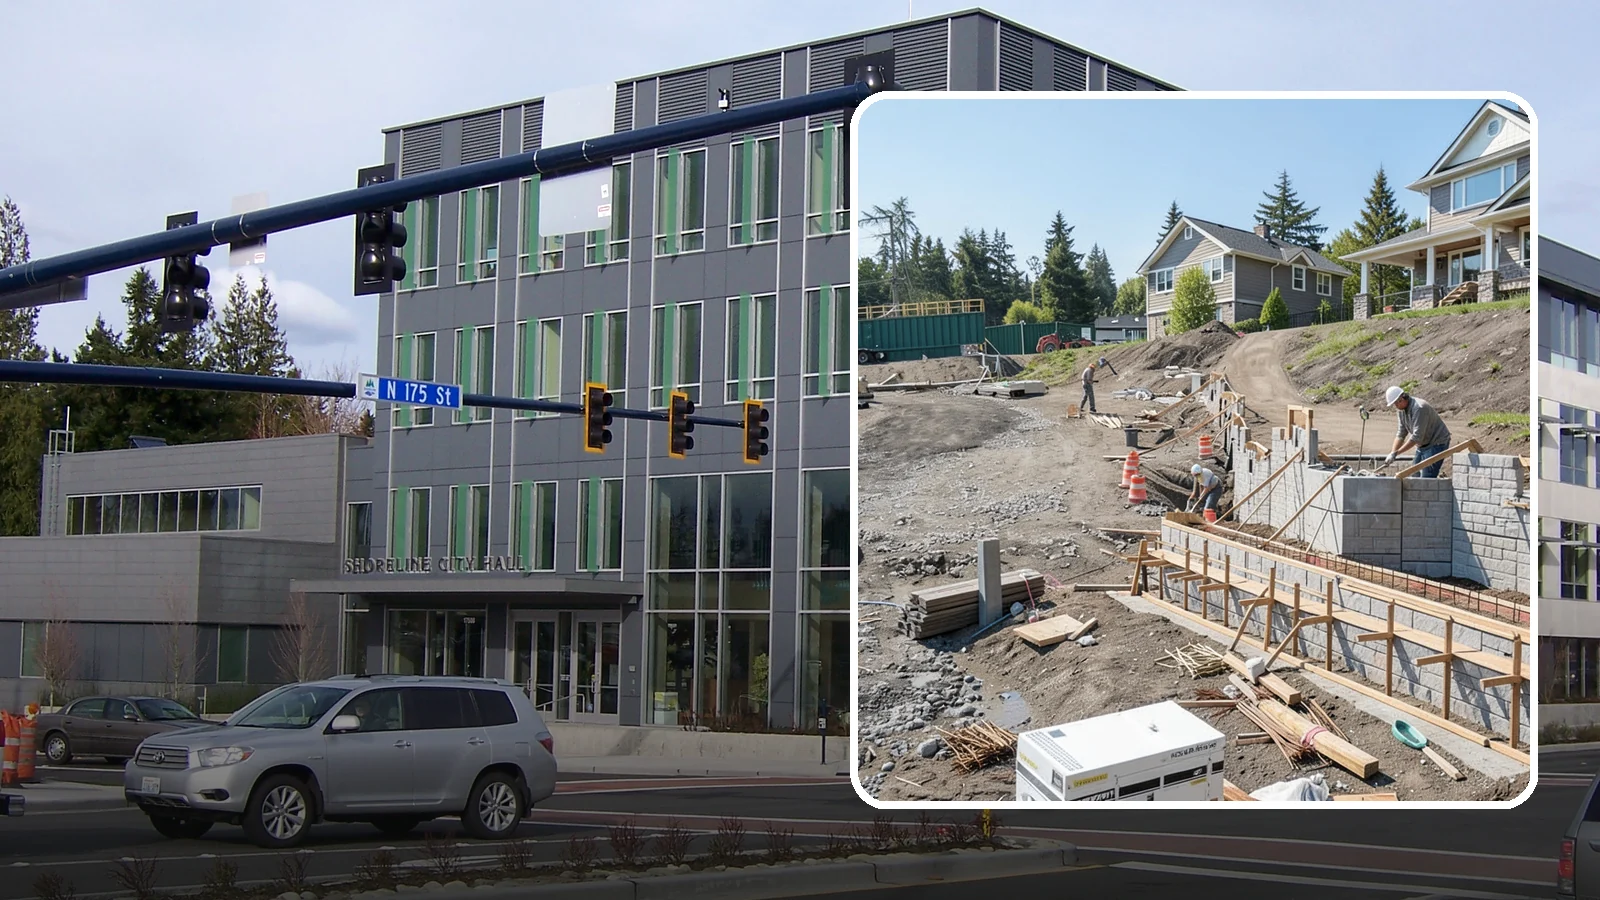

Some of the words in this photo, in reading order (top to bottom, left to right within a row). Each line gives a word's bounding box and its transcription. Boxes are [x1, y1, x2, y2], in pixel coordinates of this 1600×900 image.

[387, 380, 396, 399] N
[405, 382, 428, 403] 175
[436, 386, 452, 406] St
[343, 557, 432, 574] SHORELINE
[438, 556, 475, 572] CITY
[484, 555, 525, 571] HALL
